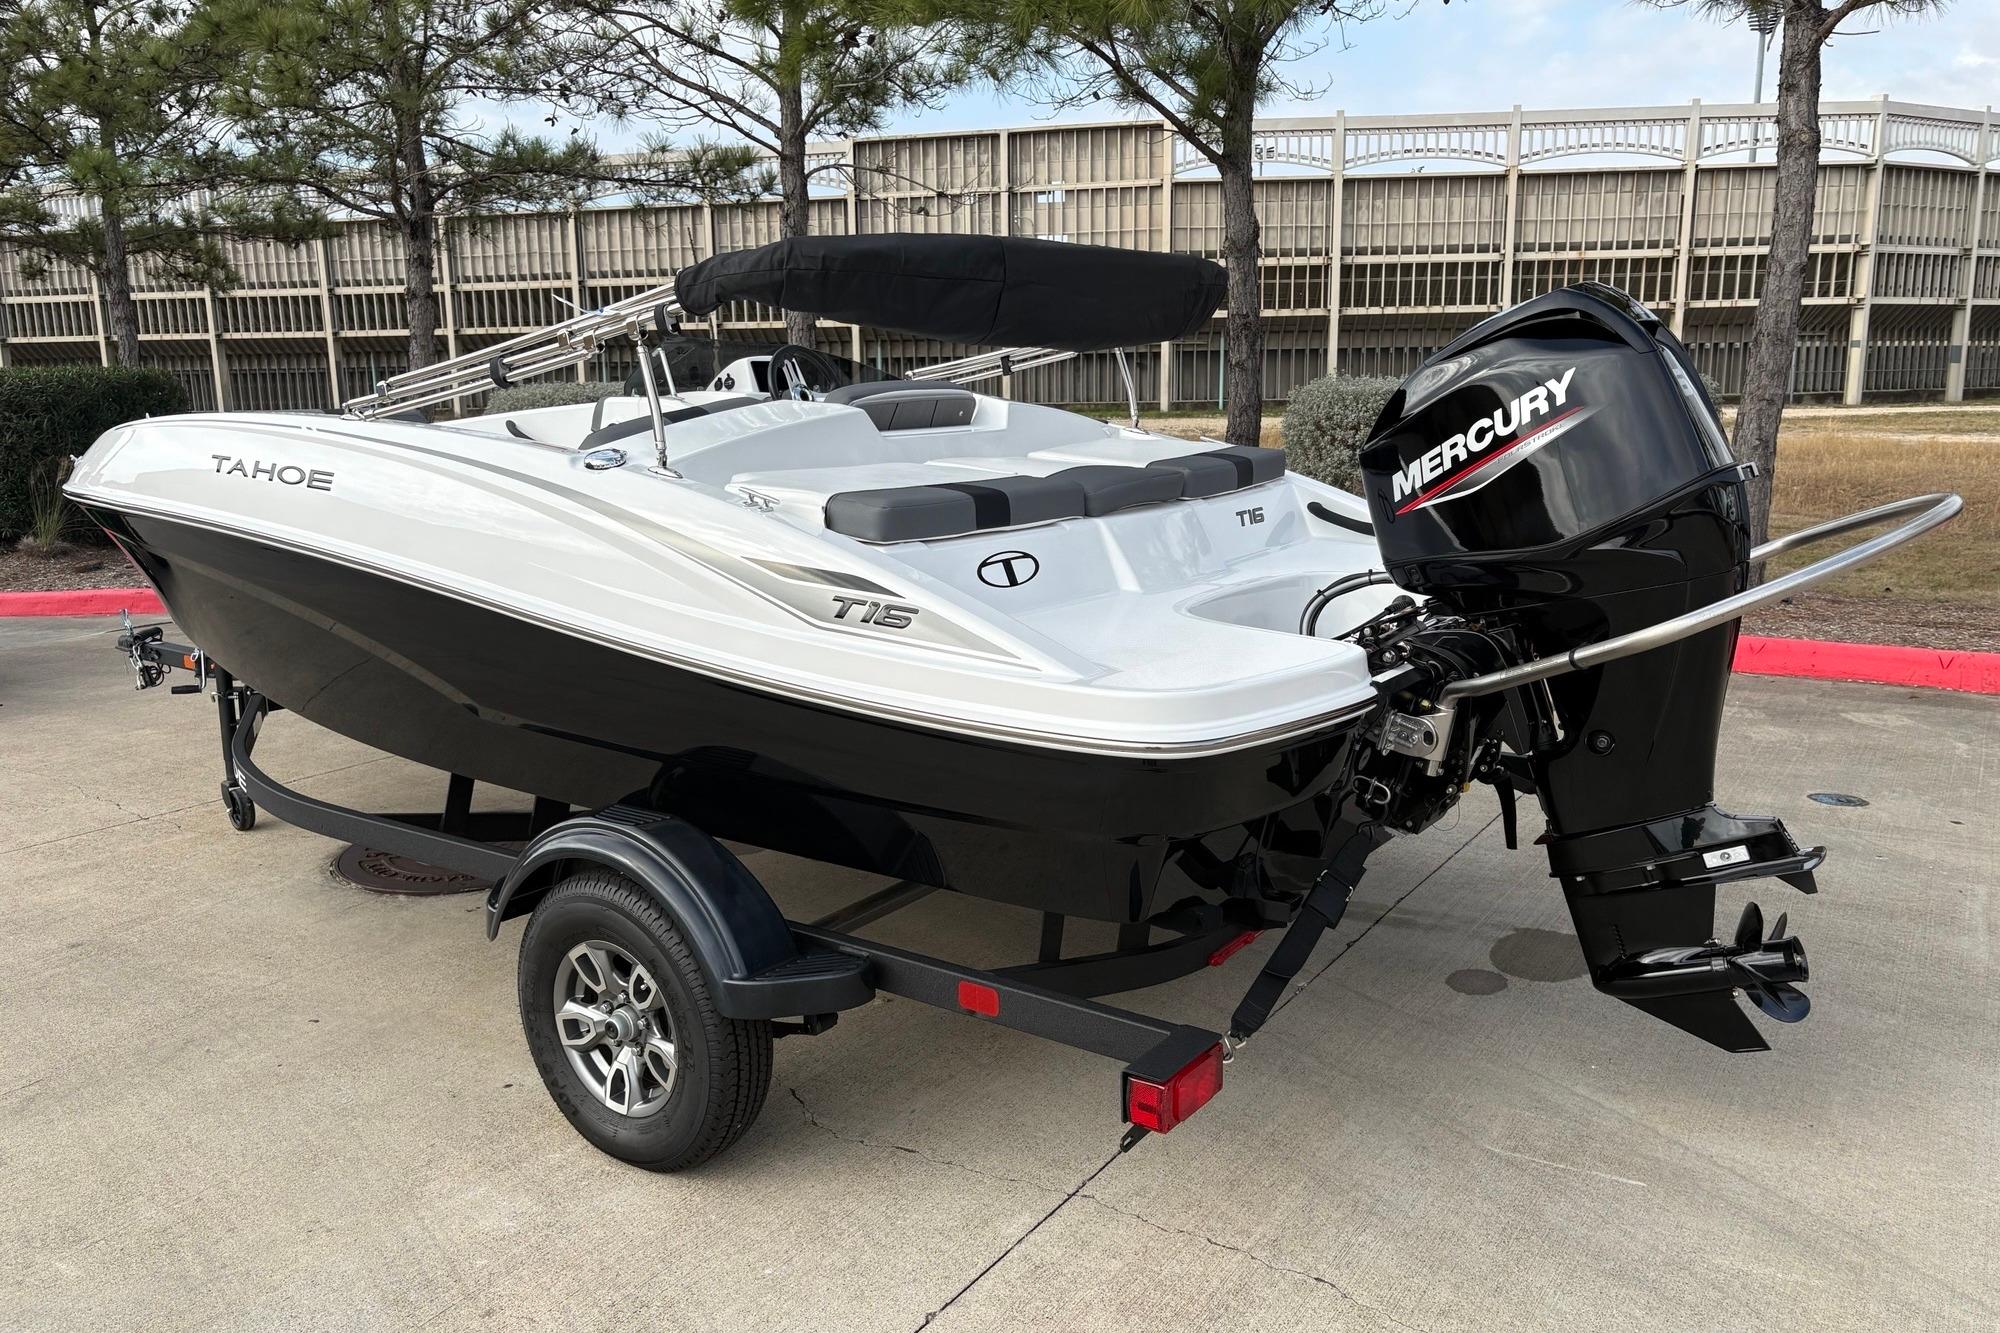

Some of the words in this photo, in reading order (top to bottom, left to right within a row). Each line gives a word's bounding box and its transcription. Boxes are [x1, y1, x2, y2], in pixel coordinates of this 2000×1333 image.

[1391, 366, 1577, 502] MERCURY
[211, 454, 335, 492] TAHOE
[1235, 506, 1265, 527] T16
[832, 595, 920, 629] T16
